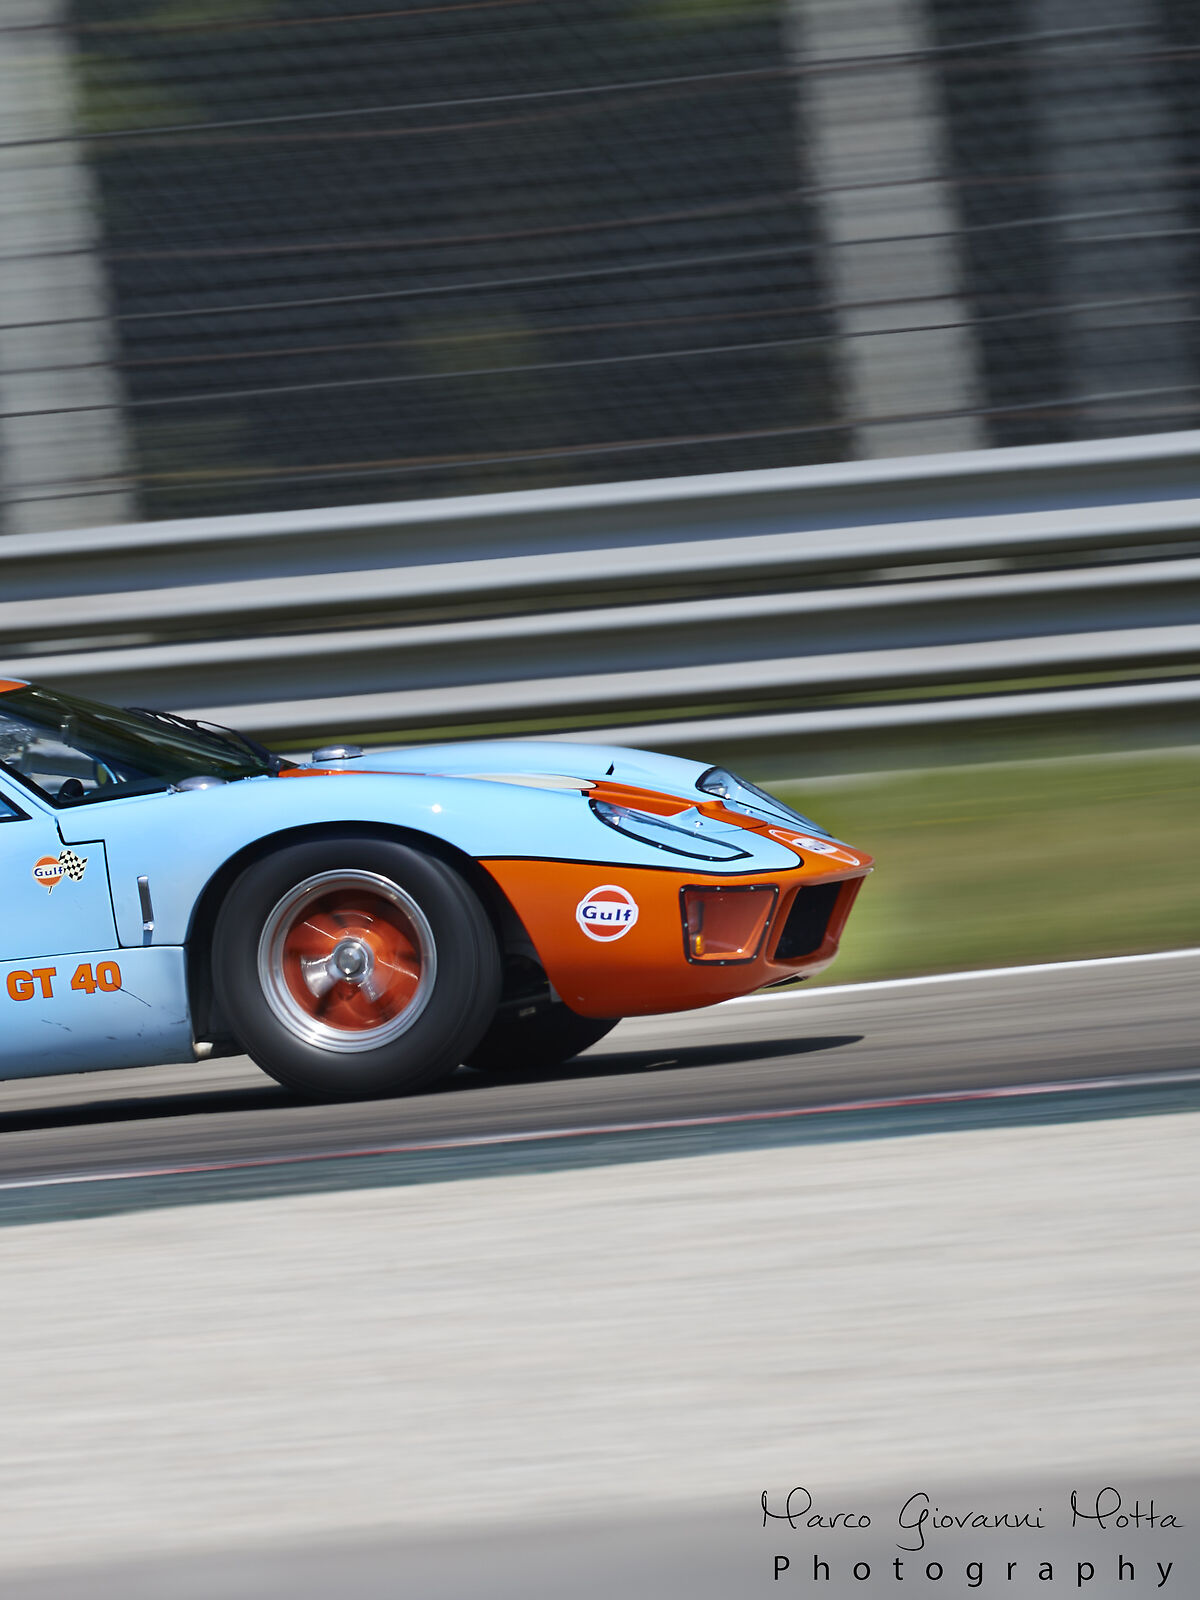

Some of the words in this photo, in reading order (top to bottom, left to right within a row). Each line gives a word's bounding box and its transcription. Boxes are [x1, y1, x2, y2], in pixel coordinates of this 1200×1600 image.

[34, 866, 63, 877] Gulf
[582, 905, 632, 921] Gulf
[7, 967, 57, 1001] GT
[70, 961, 122, 994] 40
